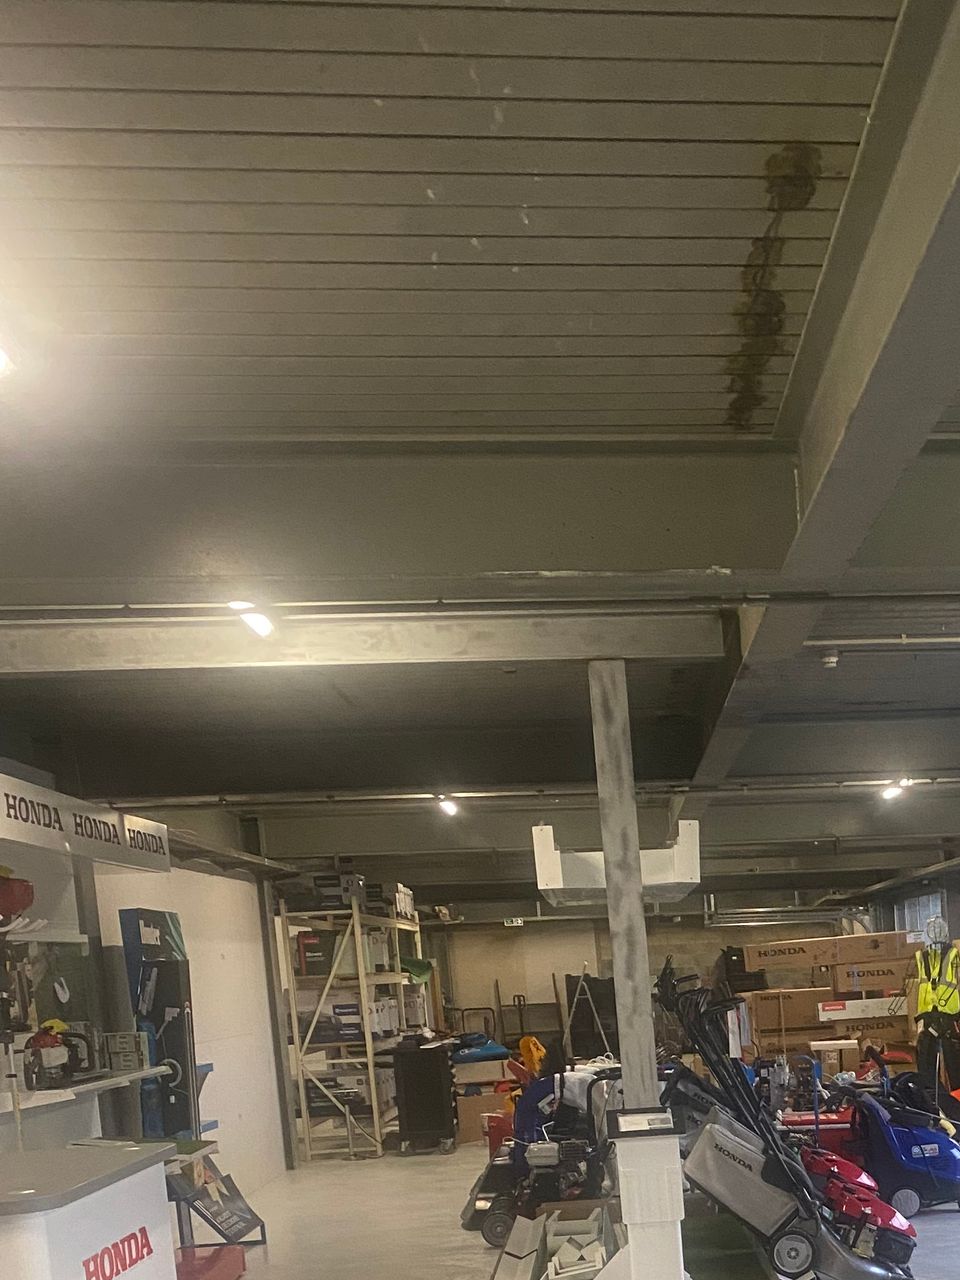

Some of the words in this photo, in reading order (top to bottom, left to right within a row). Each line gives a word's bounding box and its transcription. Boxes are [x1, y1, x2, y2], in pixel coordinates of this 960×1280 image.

[4, 793, 65, 832] HONDA
[73, 813, 121, 845] HONDA
[127, 828, 166, 855] HONDA
[758, 946, 807, 958] HONDA
[846, 968, 896, 979] HONDA
[845, 1021, 895, 1032] HONDA
[714, 1143, 754, 1172] HONDA
